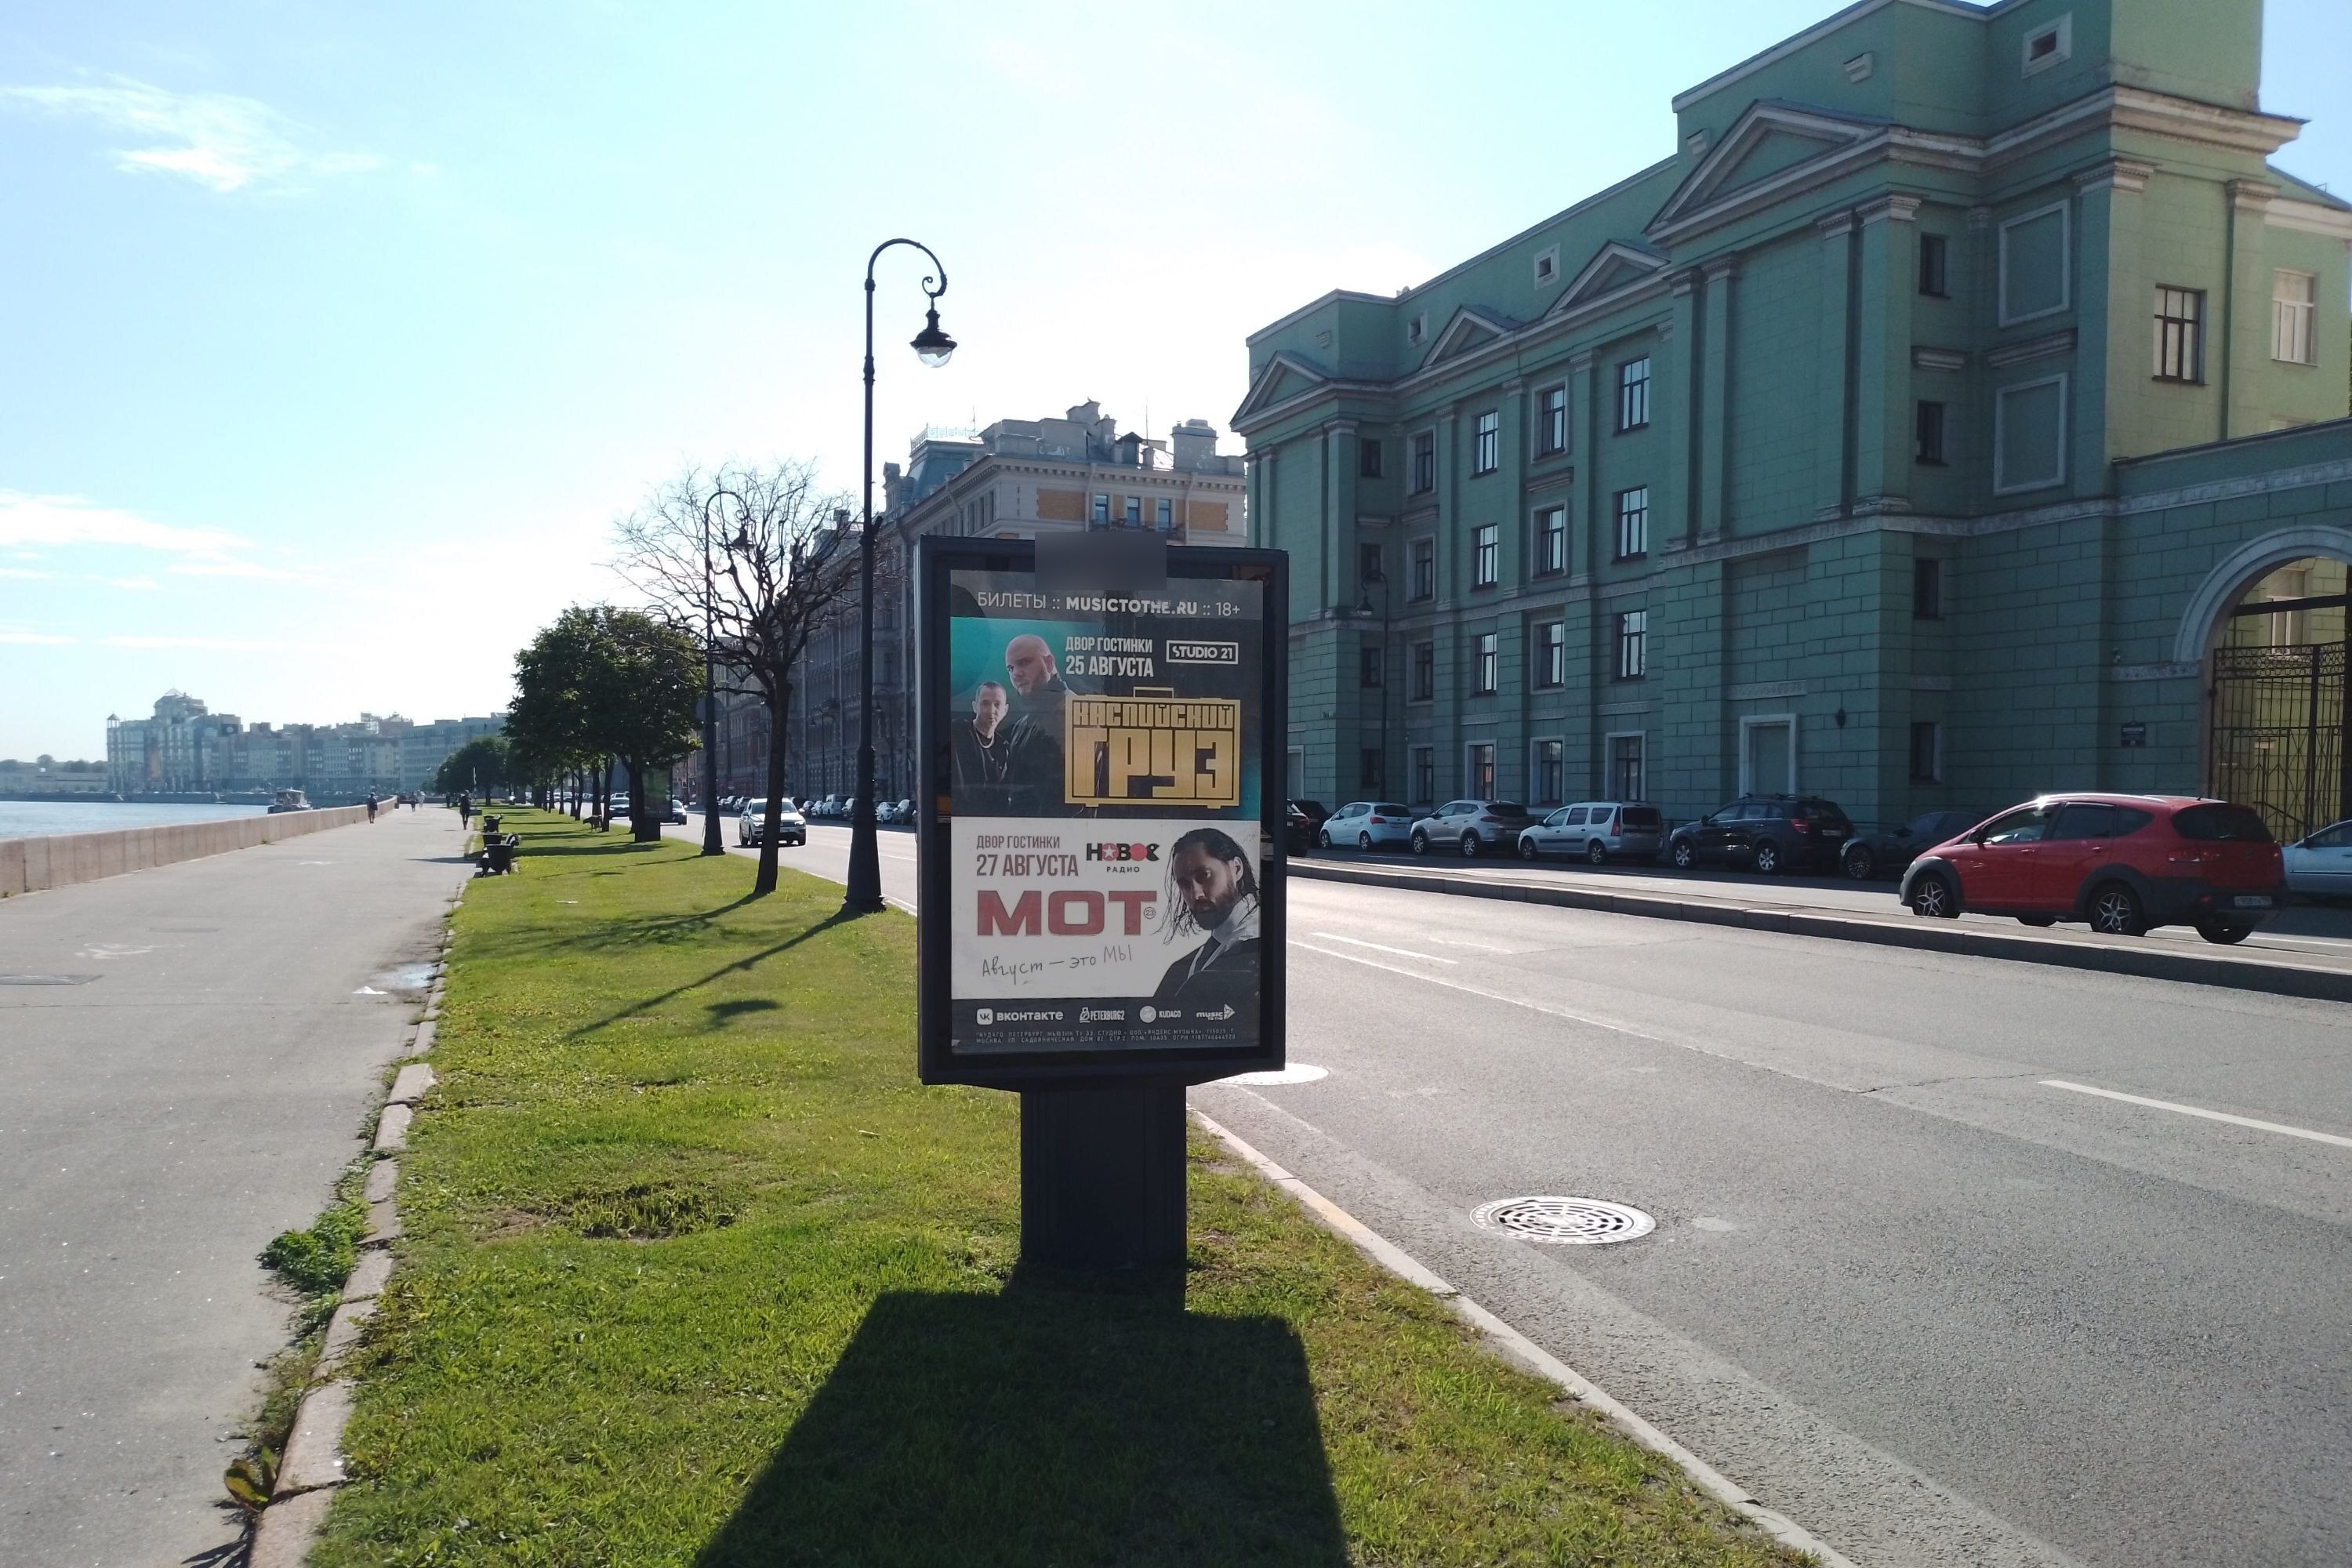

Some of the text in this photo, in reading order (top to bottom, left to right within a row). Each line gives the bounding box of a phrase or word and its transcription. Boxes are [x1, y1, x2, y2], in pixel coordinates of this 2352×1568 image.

[978, 592, 1046, 609] БИЛЕТЫ
[1066, 596, 1197, 615] MUSICTOTHE.RU
[1216, 602, 1240, 616] 18+
[1065, 636, 1152, 653] ДВОР ГОСТИНКИ
[1172, 645, 1232, 659] STUDIO 21
[1065, 655, 1154, 677] 25 АВГУСТА
[1073, 702, 1232, 728] КАСПИЙСКИЙ
[1073, 727, 1233, 798] ГРУЗ
[976, 836, 1060, 849] ДВОР ГОСТИНКИ
[976, 854, 1079, 877] 27 АВГУСТА
[977, 890, 1157, 936] МОТ
[1145, 908, 1155, 917] 23
[982, 956, 1044, 985] Август
[1069, 956, 1097, 968] это
